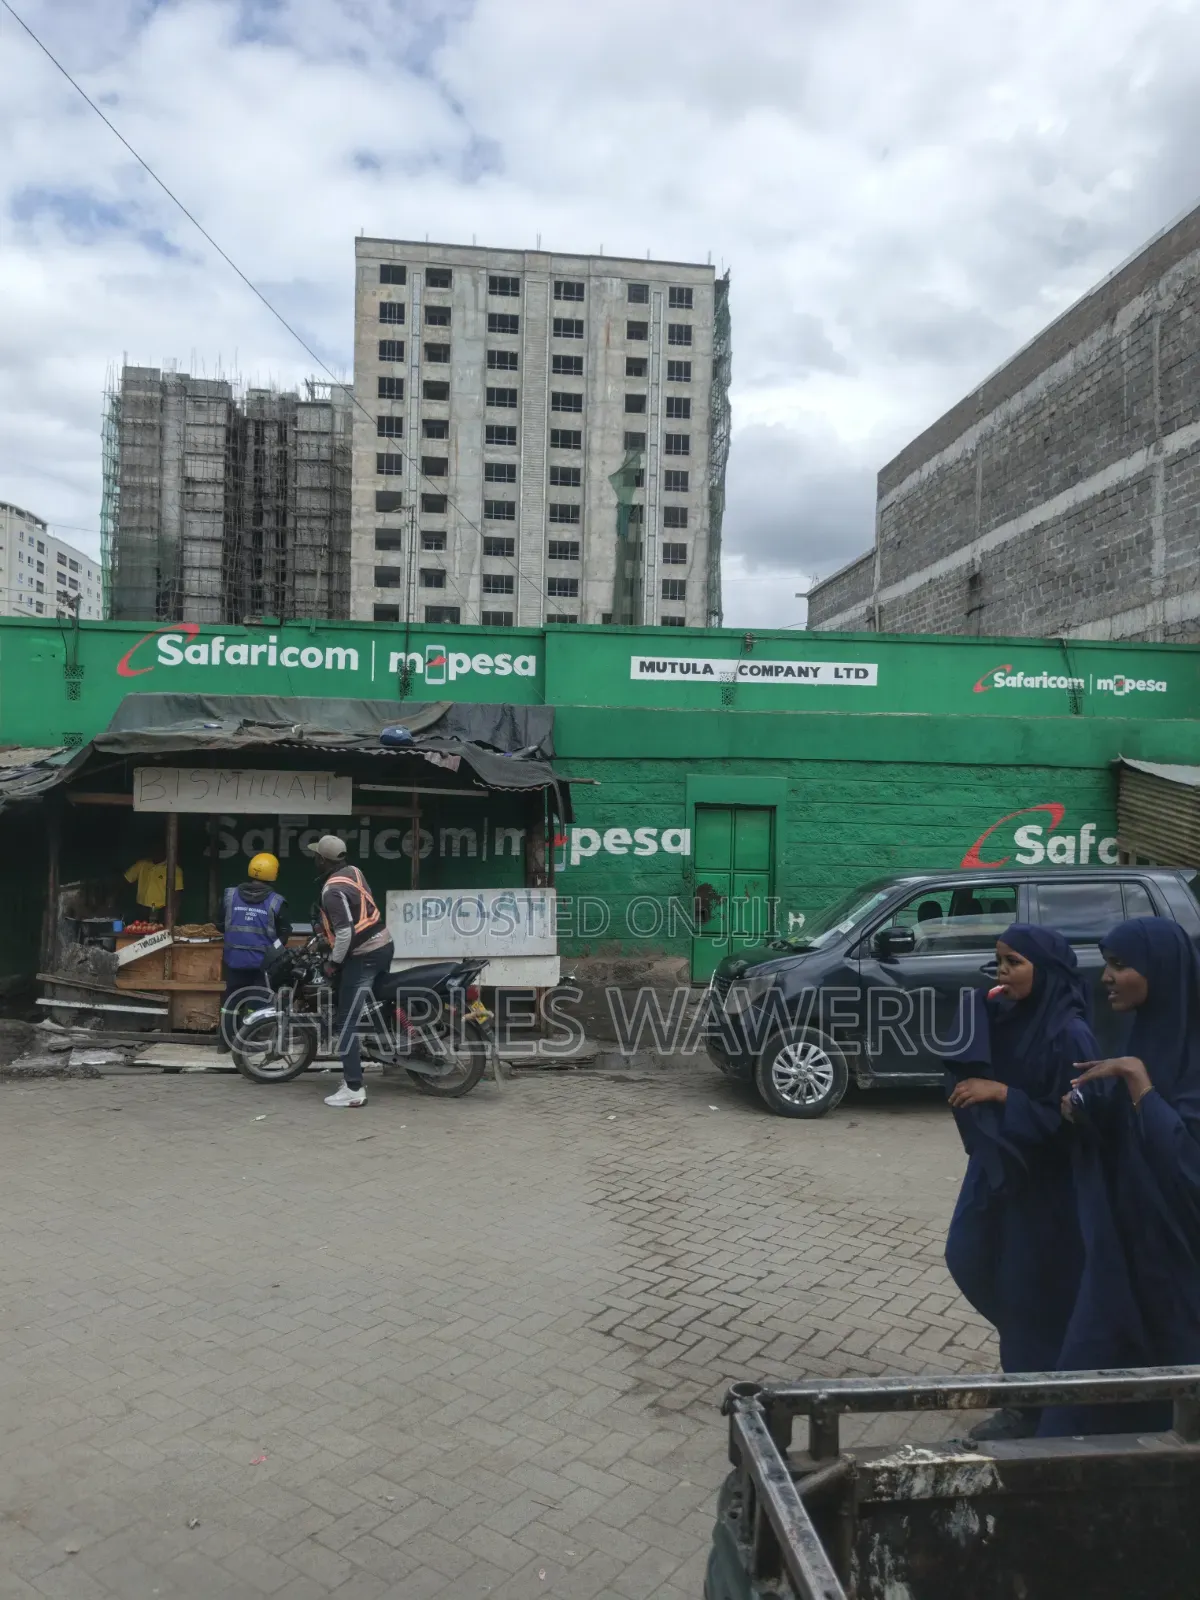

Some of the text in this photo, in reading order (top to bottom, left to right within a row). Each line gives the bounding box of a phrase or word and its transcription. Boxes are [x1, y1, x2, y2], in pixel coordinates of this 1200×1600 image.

[157, 634, 359, 670] Safaricom
[639, 660, 869, 680] MUTULA COMPANY LTD
[993, 671, 1085, 689] Safaricom
